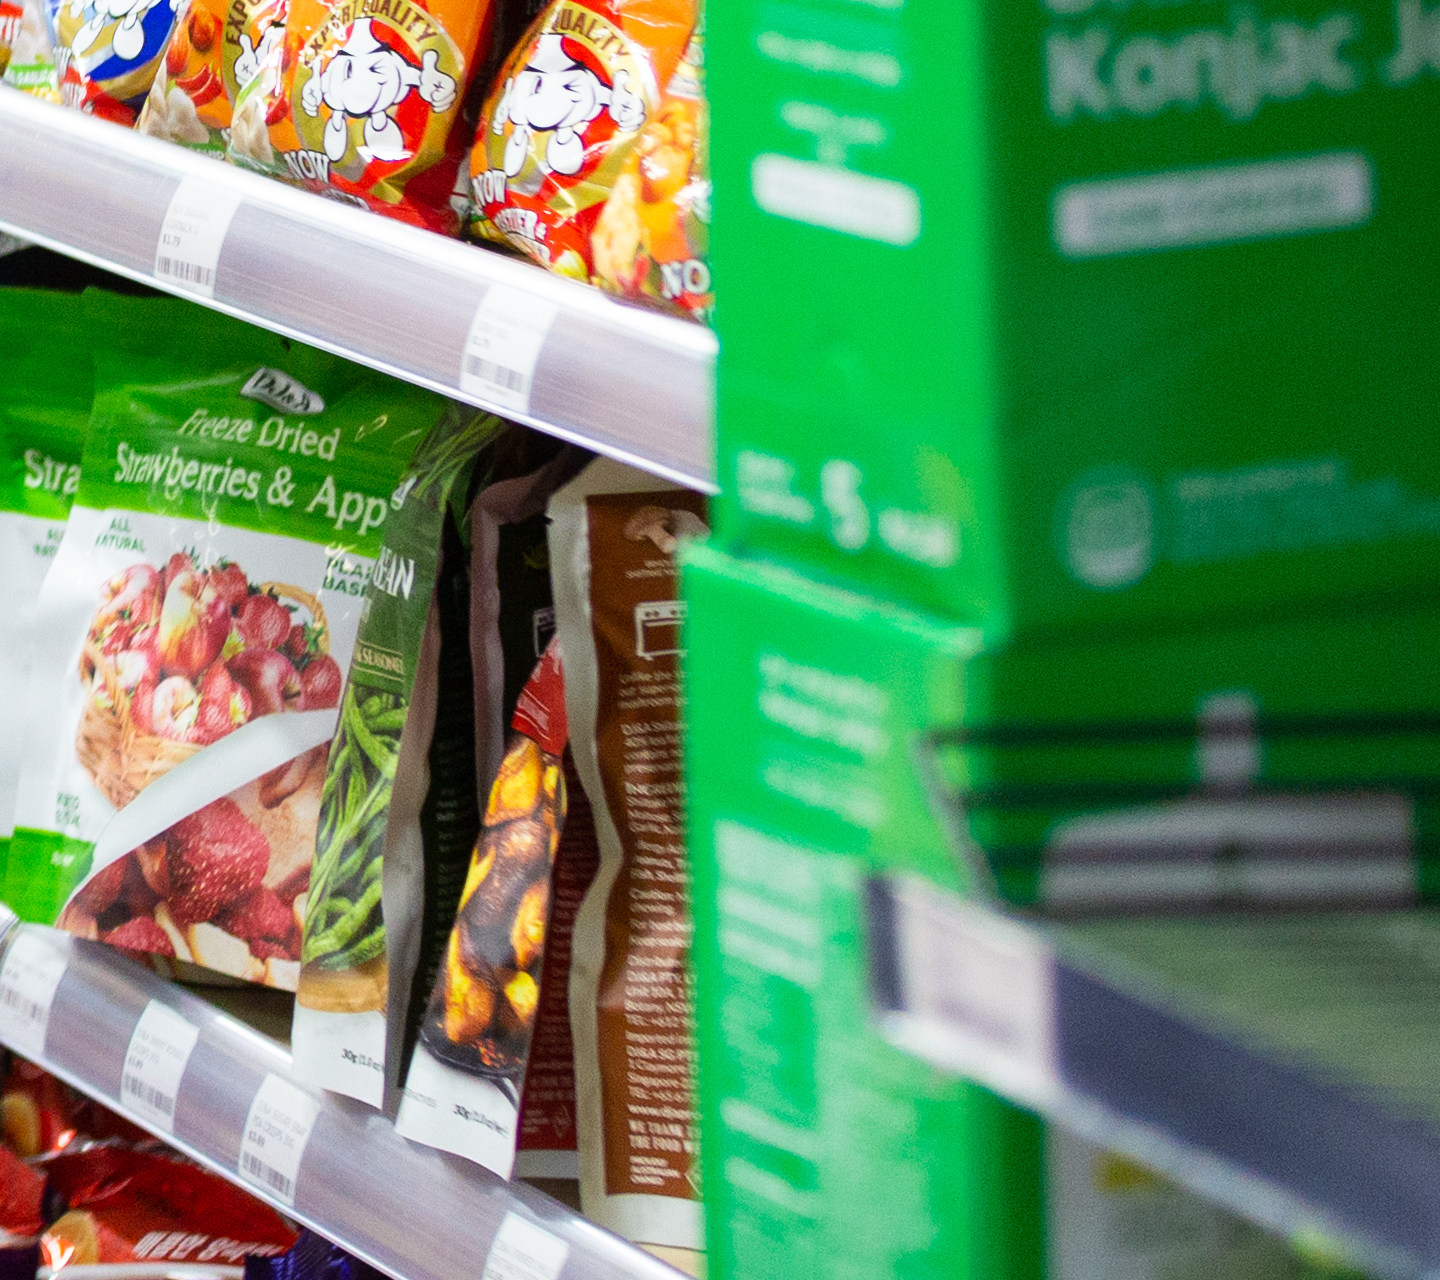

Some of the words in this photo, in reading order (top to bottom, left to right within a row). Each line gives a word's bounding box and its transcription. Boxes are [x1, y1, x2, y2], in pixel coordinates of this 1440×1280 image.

[1045, 7, 1359, 119] Konjac
[282, 148, 331, 184] NOW
[180, 408, 254, 443] Freeze
[256, 416, 341, 462] Dried
[114, 442, 262, 501] Strawberries
[266, 465, 296, 508] &
[109, 517, 132, 533] ALL
